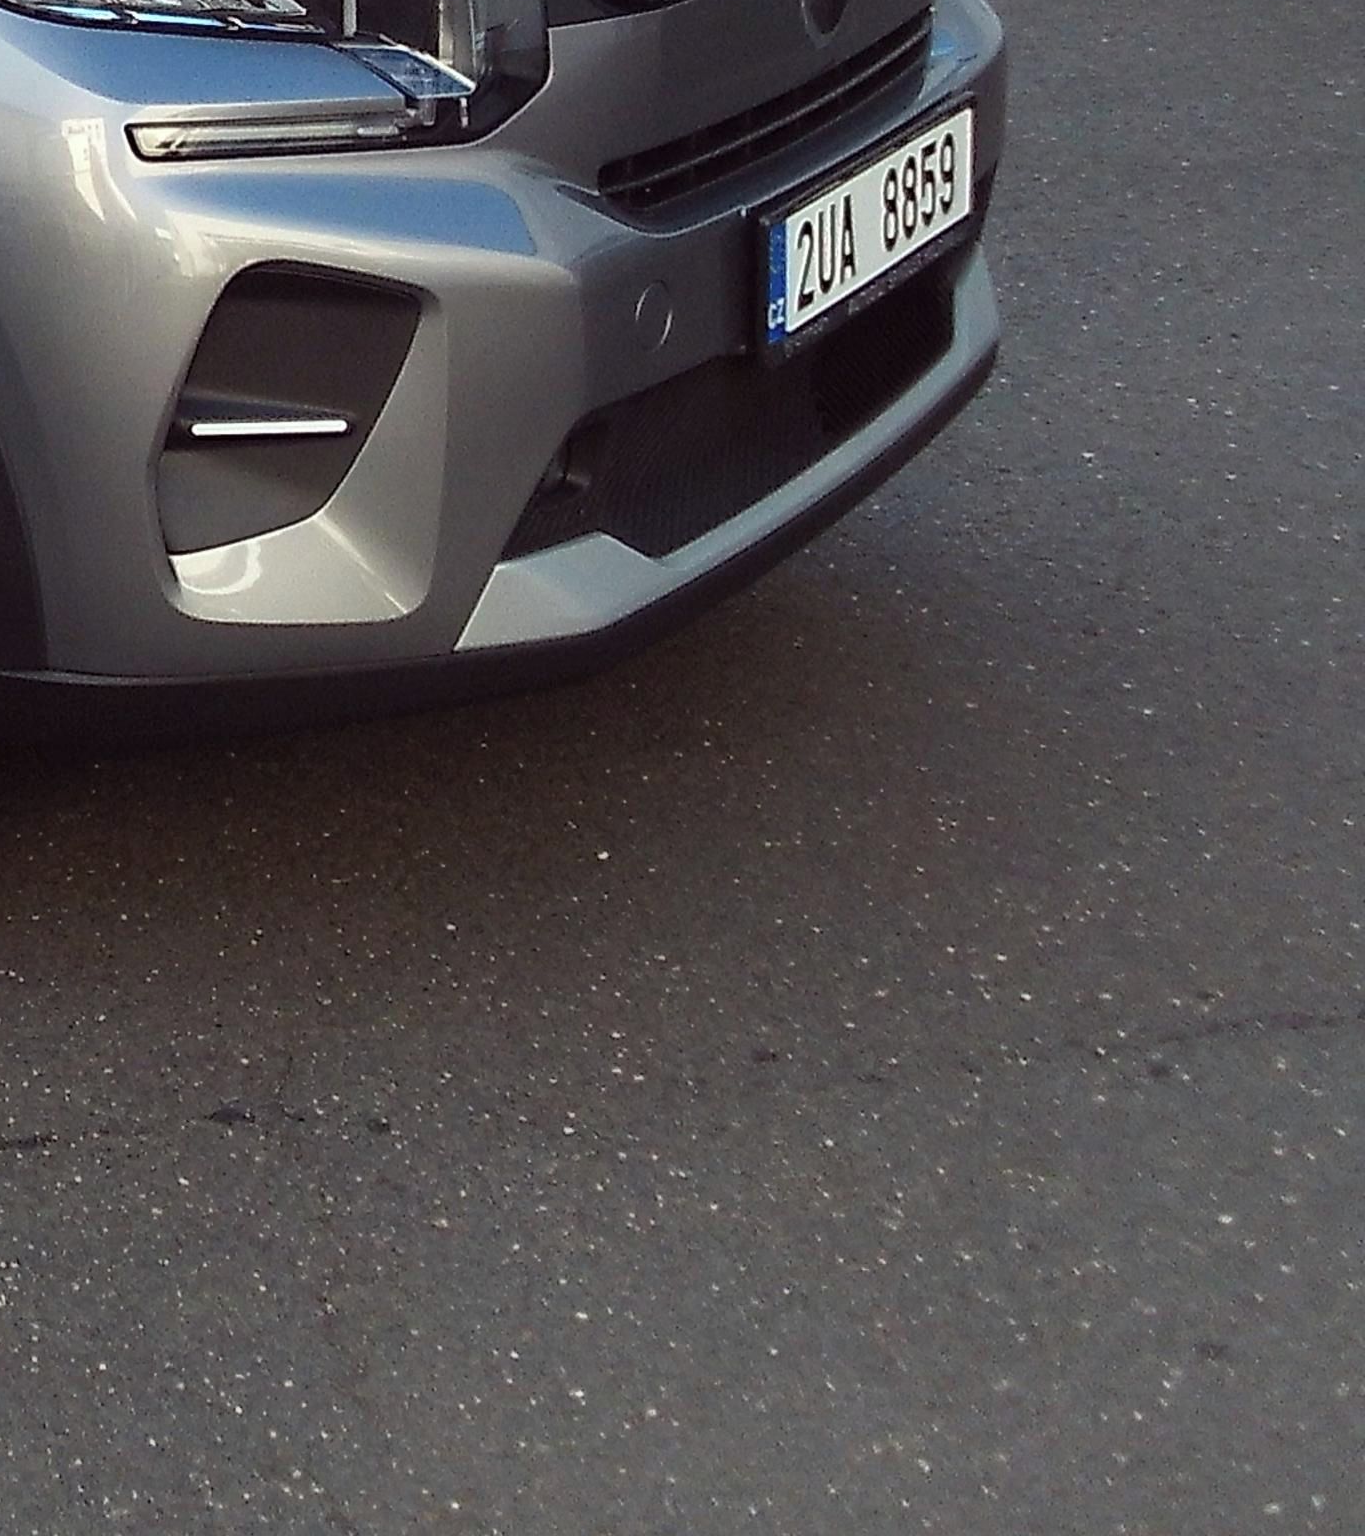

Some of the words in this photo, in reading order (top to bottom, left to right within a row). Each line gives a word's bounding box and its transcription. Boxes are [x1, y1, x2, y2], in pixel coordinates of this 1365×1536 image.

[796, 194, 857, 312] 2UA
[882, 133, 955, 252] 8859
[768, 297, 785, 330] CZ
